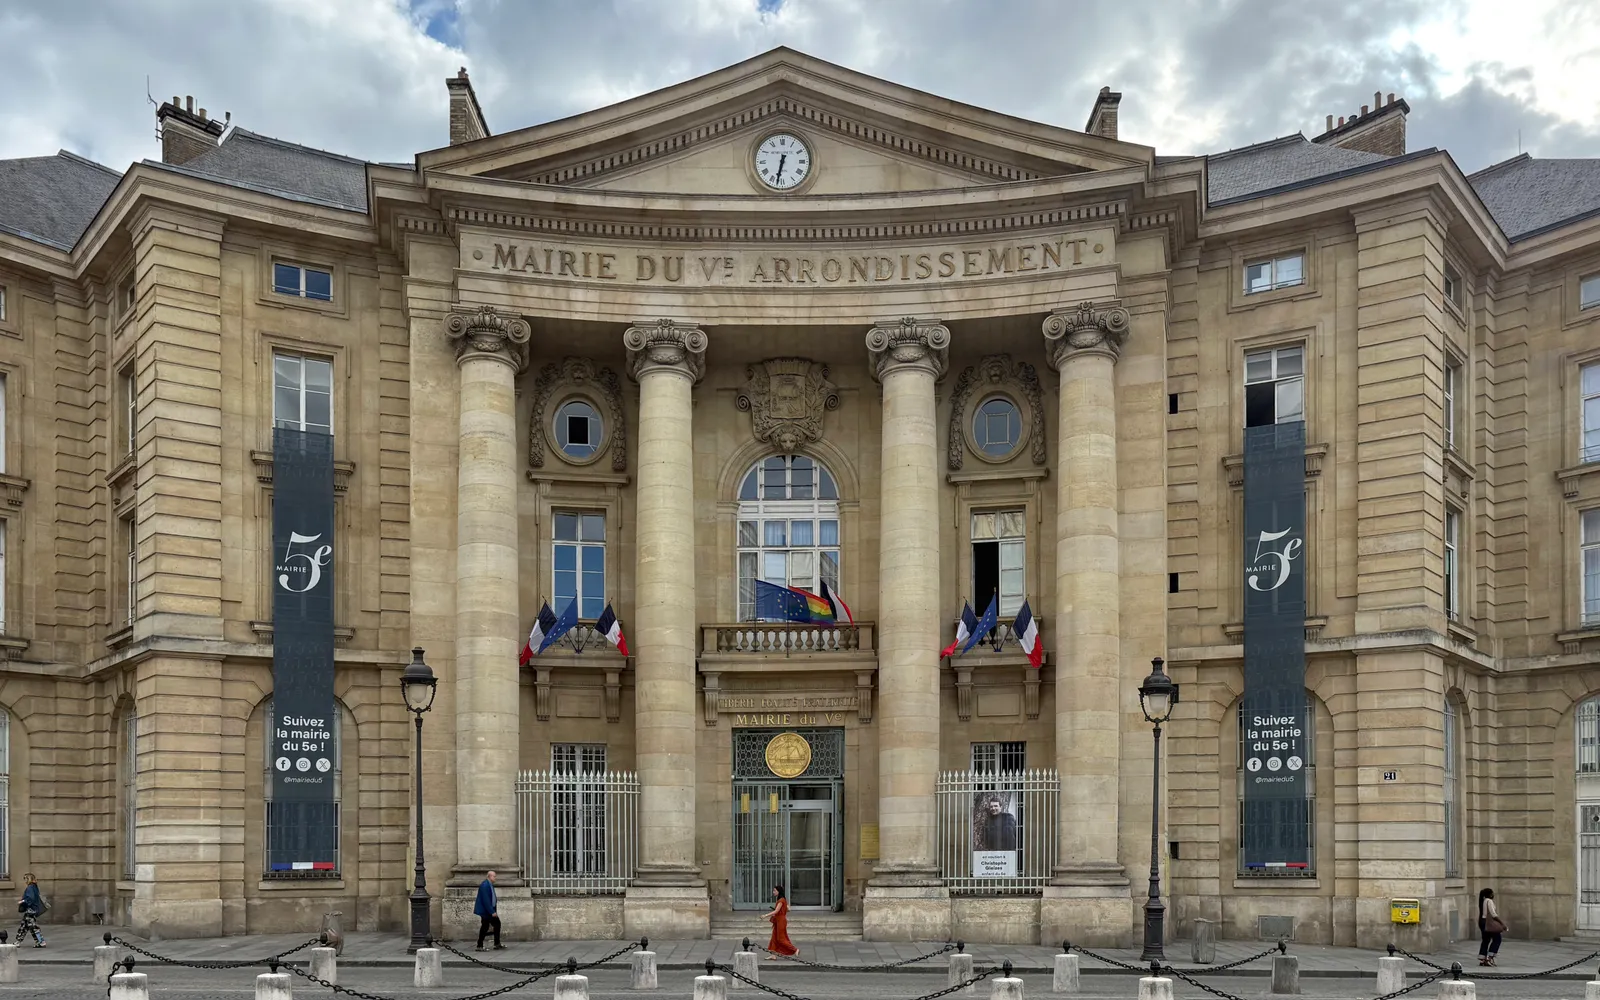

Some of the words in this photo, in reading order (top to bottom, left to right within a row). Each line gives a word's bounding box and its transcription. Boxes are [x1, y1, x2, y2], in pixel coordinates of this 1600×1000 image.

[492, 243, 618, 280] MAIRIE
[636, 254, 683, 281] DU
[749, 237, 1087, 283] ARRONDISSEMENT
[279, 531, 332, 592] 5e
[1248, 526, 1302, 592] 5e
[276, 565, 307, 573] MAIRIE
[1245, 564, 1277, 573] MAIRIE
[283, 715, 325, 727] Suivez
[735, 714, 791, 725] MAIRIE
[800, 713, 816, 725] du
[1253, 715, 1295, 727] Suivez
[277, 727, 288, 738] la
[291, 728, 331, 740] mairie
[1247, 728, 1259, 739] la
[1261, 726, 1302, 738] mairie
[282, 740, 299, 751] du
[302, 741, 318, 752] 5e
[321, 741, 325, 752] !
[1253, 741, 1270, 751] du
[1272, 740, 1289, 750] 5e
[1291, 739, 1296, 750] !
[283, 776, 323, 784] @mairiedu5
[1255, 775, 1295, 784] @mairiedu5
